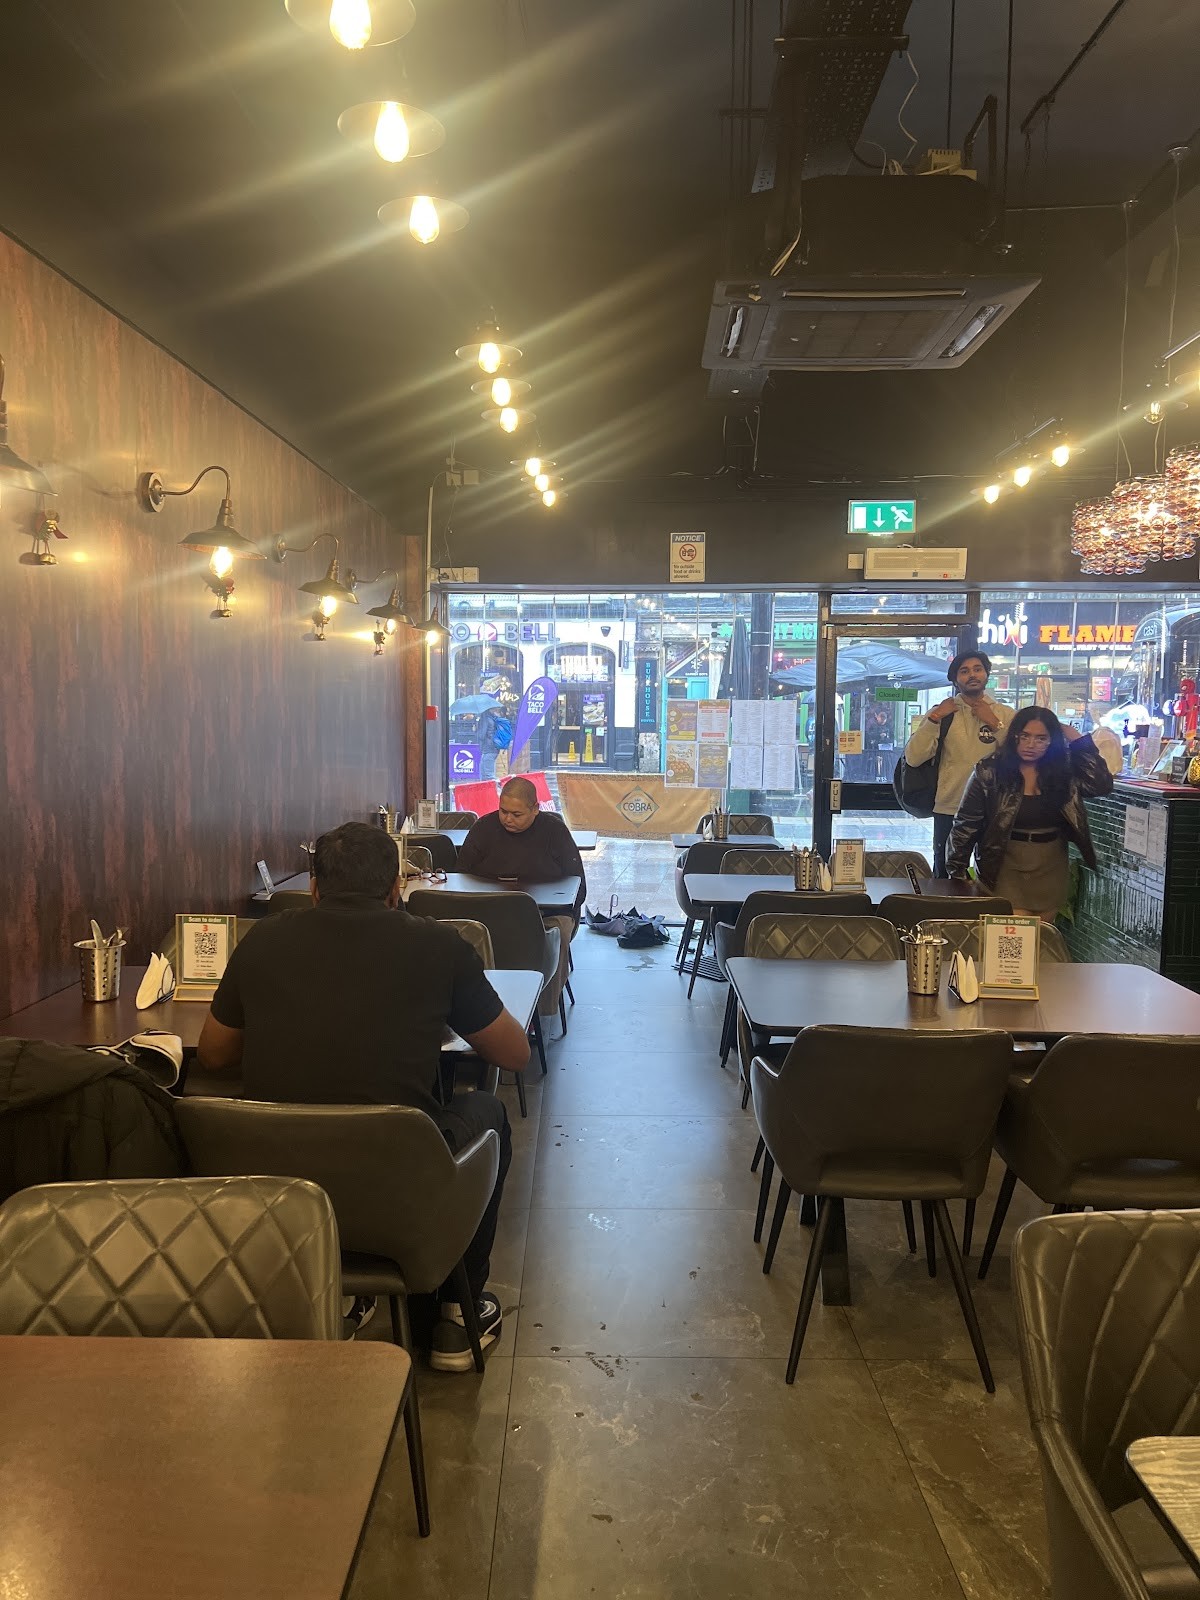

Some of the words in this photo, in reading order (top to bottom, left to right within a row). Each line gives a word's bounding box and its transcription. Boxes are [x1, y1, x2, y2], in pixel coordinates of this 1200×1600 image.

[504, 622, 561, 642] BELL
[1143, 622, 1158, 637] cash
[623, 802, 653, 811] COBRA
[202, 924, 208, 932] 3
[1005, 926, 1016, 934] 12
